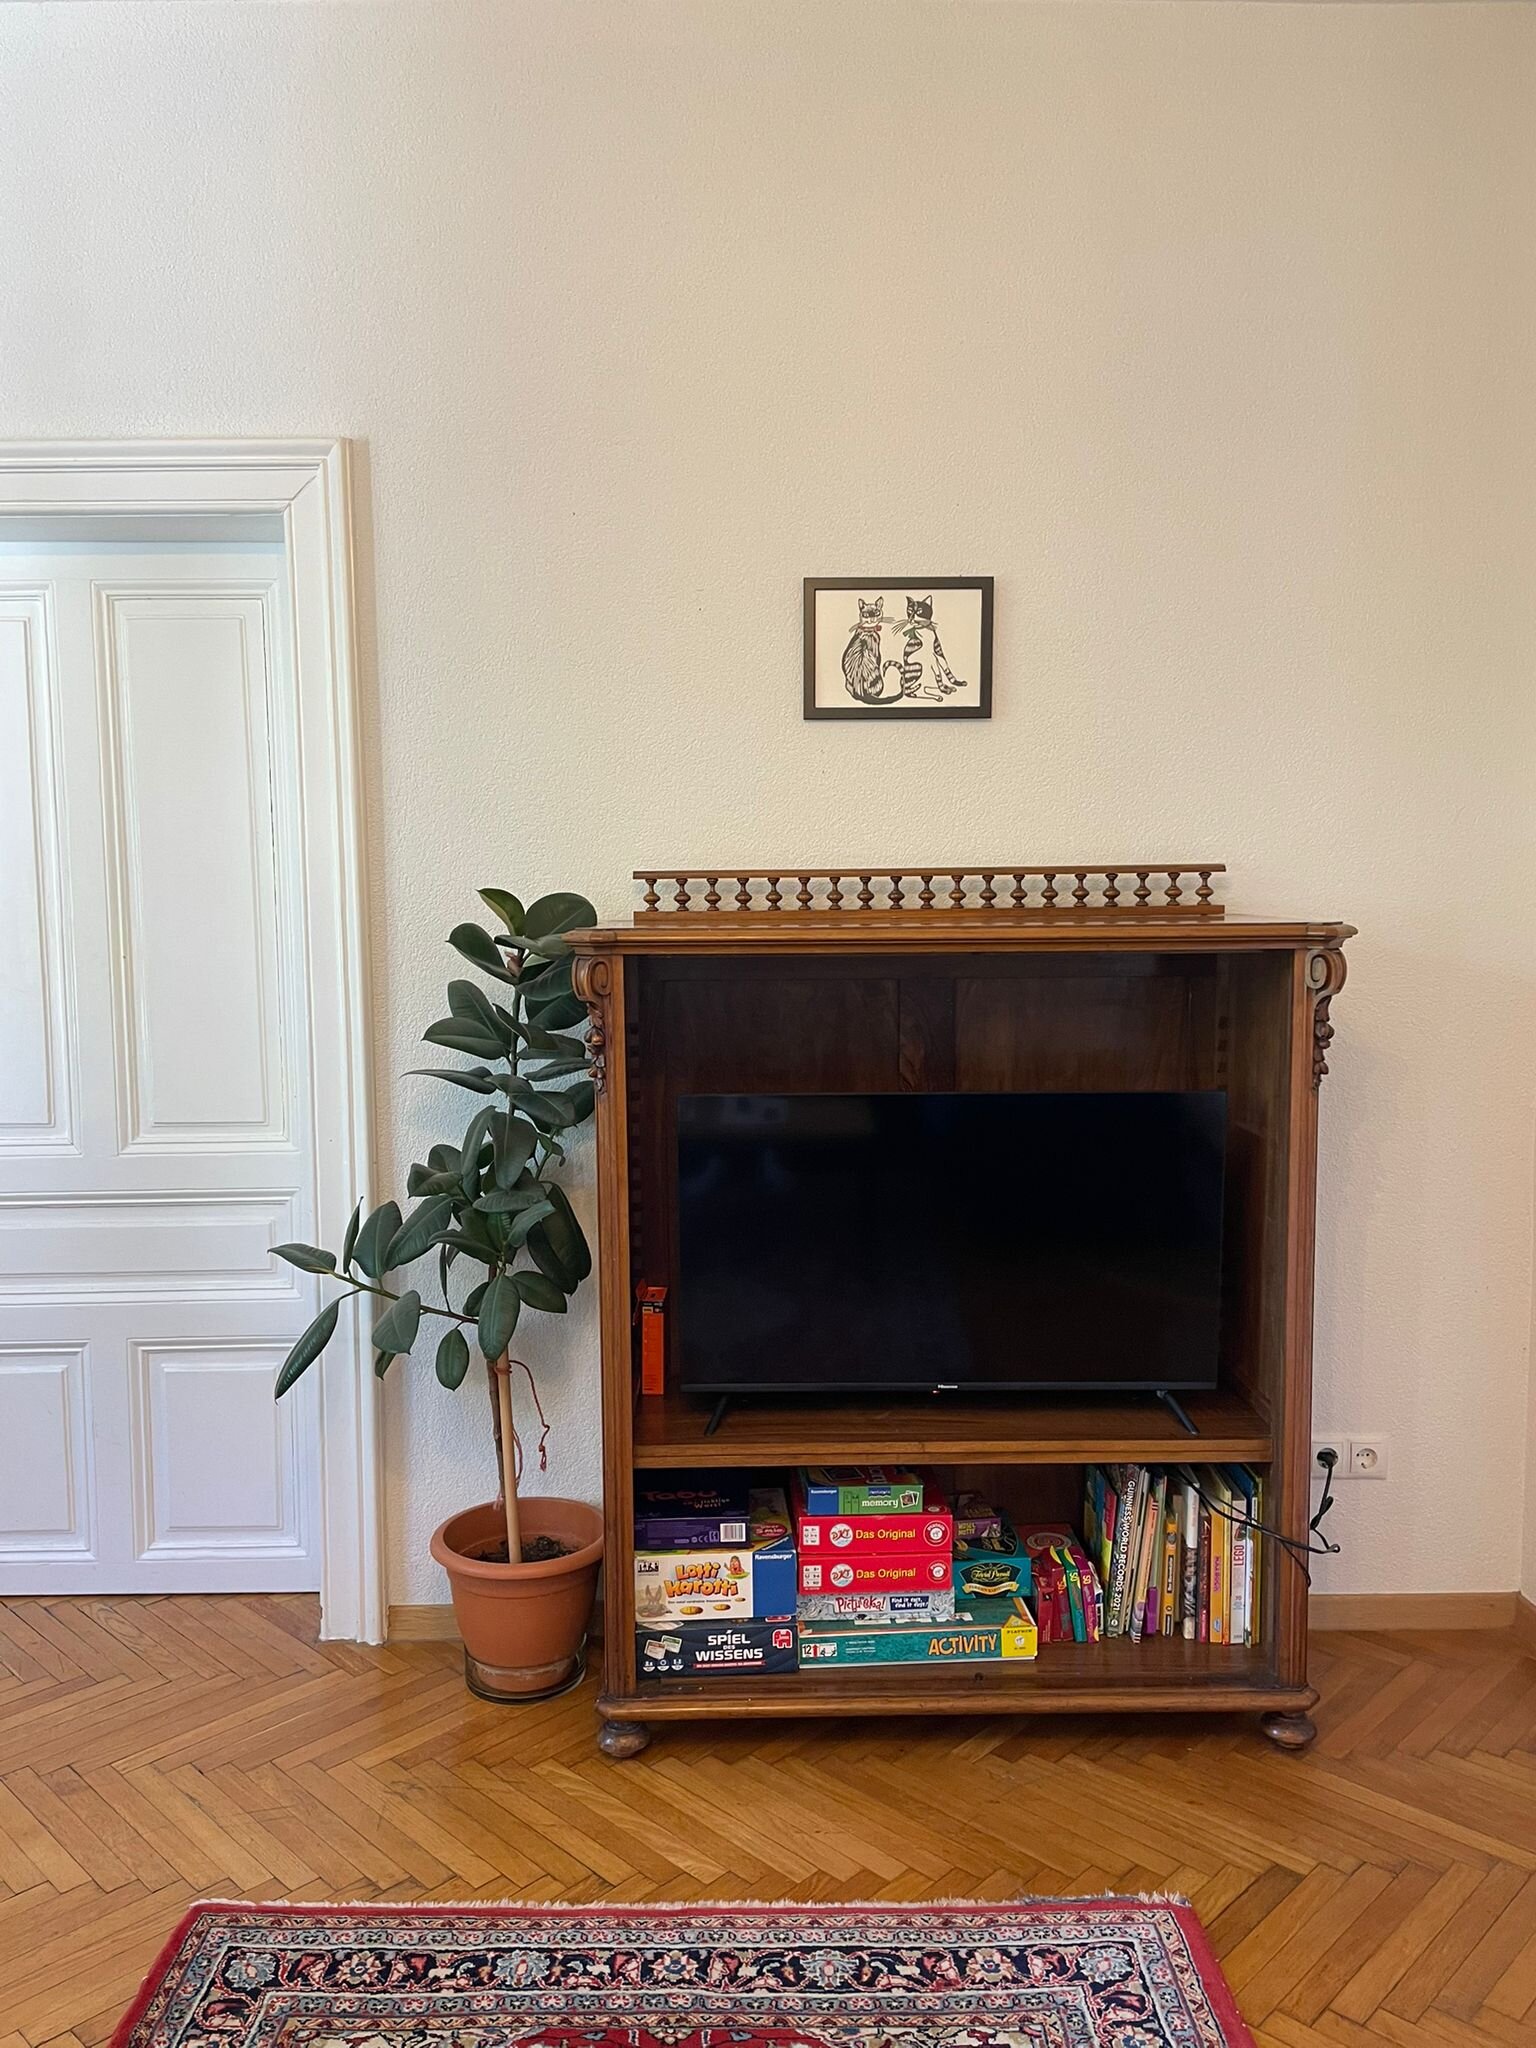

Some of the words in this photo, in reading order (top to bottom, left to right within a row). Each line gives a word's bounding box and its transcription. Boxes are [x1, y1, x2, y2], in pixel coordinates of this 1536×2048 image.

[862, 1499, 899, 1508] memory
[1124, 1480, 1136, 1521] GUINNESS
[831, 1529, 850, 1541] DKT
[855, 1530, 875, 1539] Das
[877, 1529, 916, 1541] Original
[1119, 1521, 1130, 1553] WORLD
[1233, 1544, 1245, 1567] LEGO
[675, 1562, 721, 1581] Lotti
[832, 1569, 851, 1581] DKT
[856, 1569, 876, 1579] Das
[878, 1568, 916, 1580] Original
[1115, 1553, 1127, 1592] RECORDS
[664, 1578, 739, 1598] Karotti
[835, 1595, 887, 1613] Pictureka!
[1112, 1593, 1122, 1611] 2021
[707, 1630, 751, 1646] SPIEL
[928, 1633, 997, 1656] ACTIVITY
[695, 1648, 764, 1662] WISSENS
[802, 1645, 812, 1655] 12
